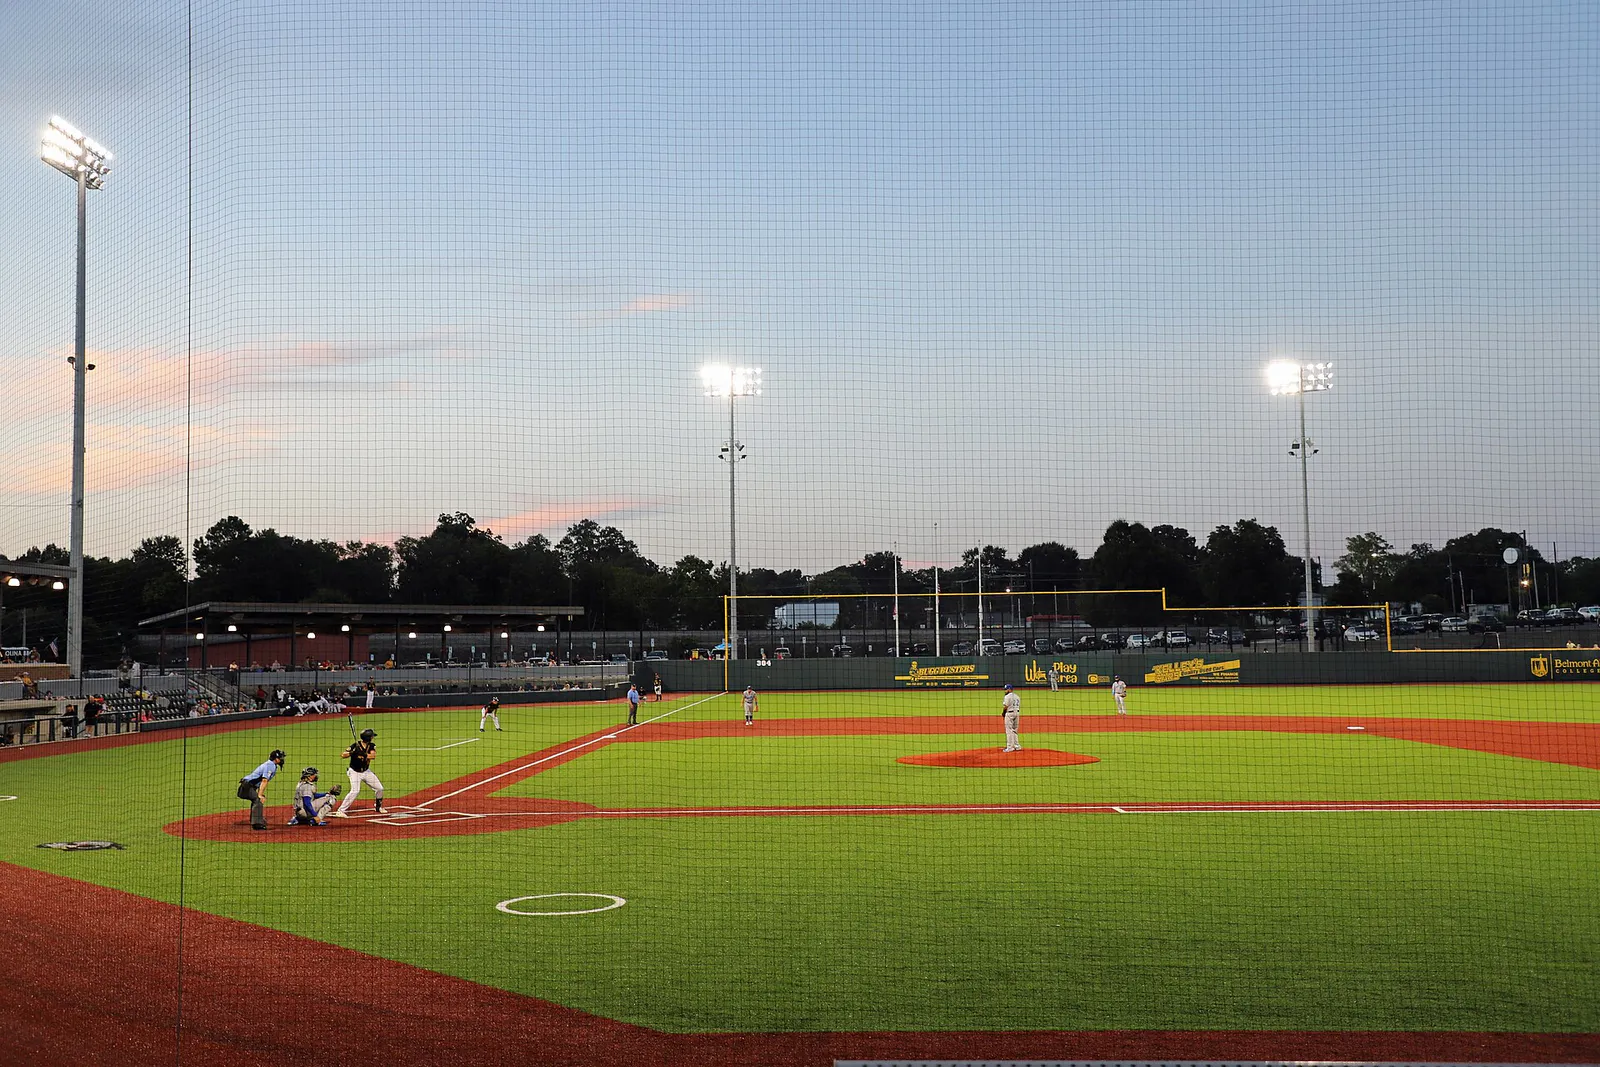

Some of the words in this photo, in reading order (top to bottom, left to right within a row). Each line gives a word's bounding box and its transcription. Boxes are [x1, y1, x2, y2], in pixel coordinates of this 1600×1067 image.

[1053, 661, 1077, 674] Play
[1554, 659, 1592, 668] Belmont
[918, 667, 940, 676] BUGG
[939, 664, 976, 675] BUSTERS
[1056, 674, 1078, 684] rea
